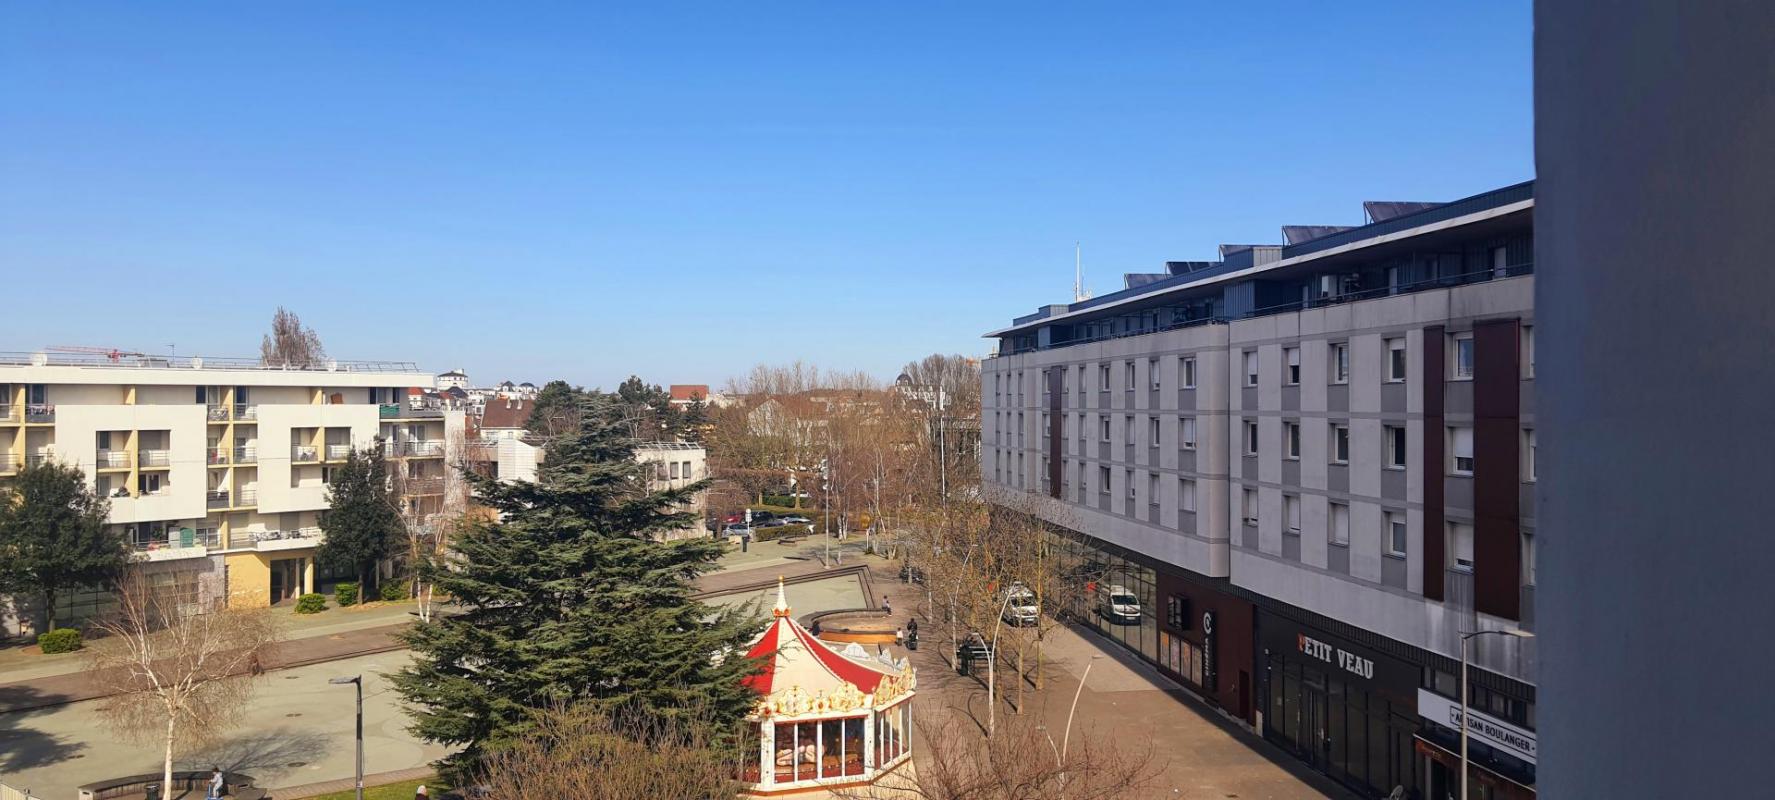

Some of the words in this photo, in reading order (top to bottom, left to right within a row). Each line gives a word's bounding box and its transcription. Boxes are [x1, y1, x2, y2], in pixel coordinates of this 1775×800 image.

[1297, 633, 1332, 663] PETIT
[1337, 648, 1374, 679] VEAU
[1455, 713, 1484, 732] ARISAN
[1485, 725, 1530, 752] BOULANGER
